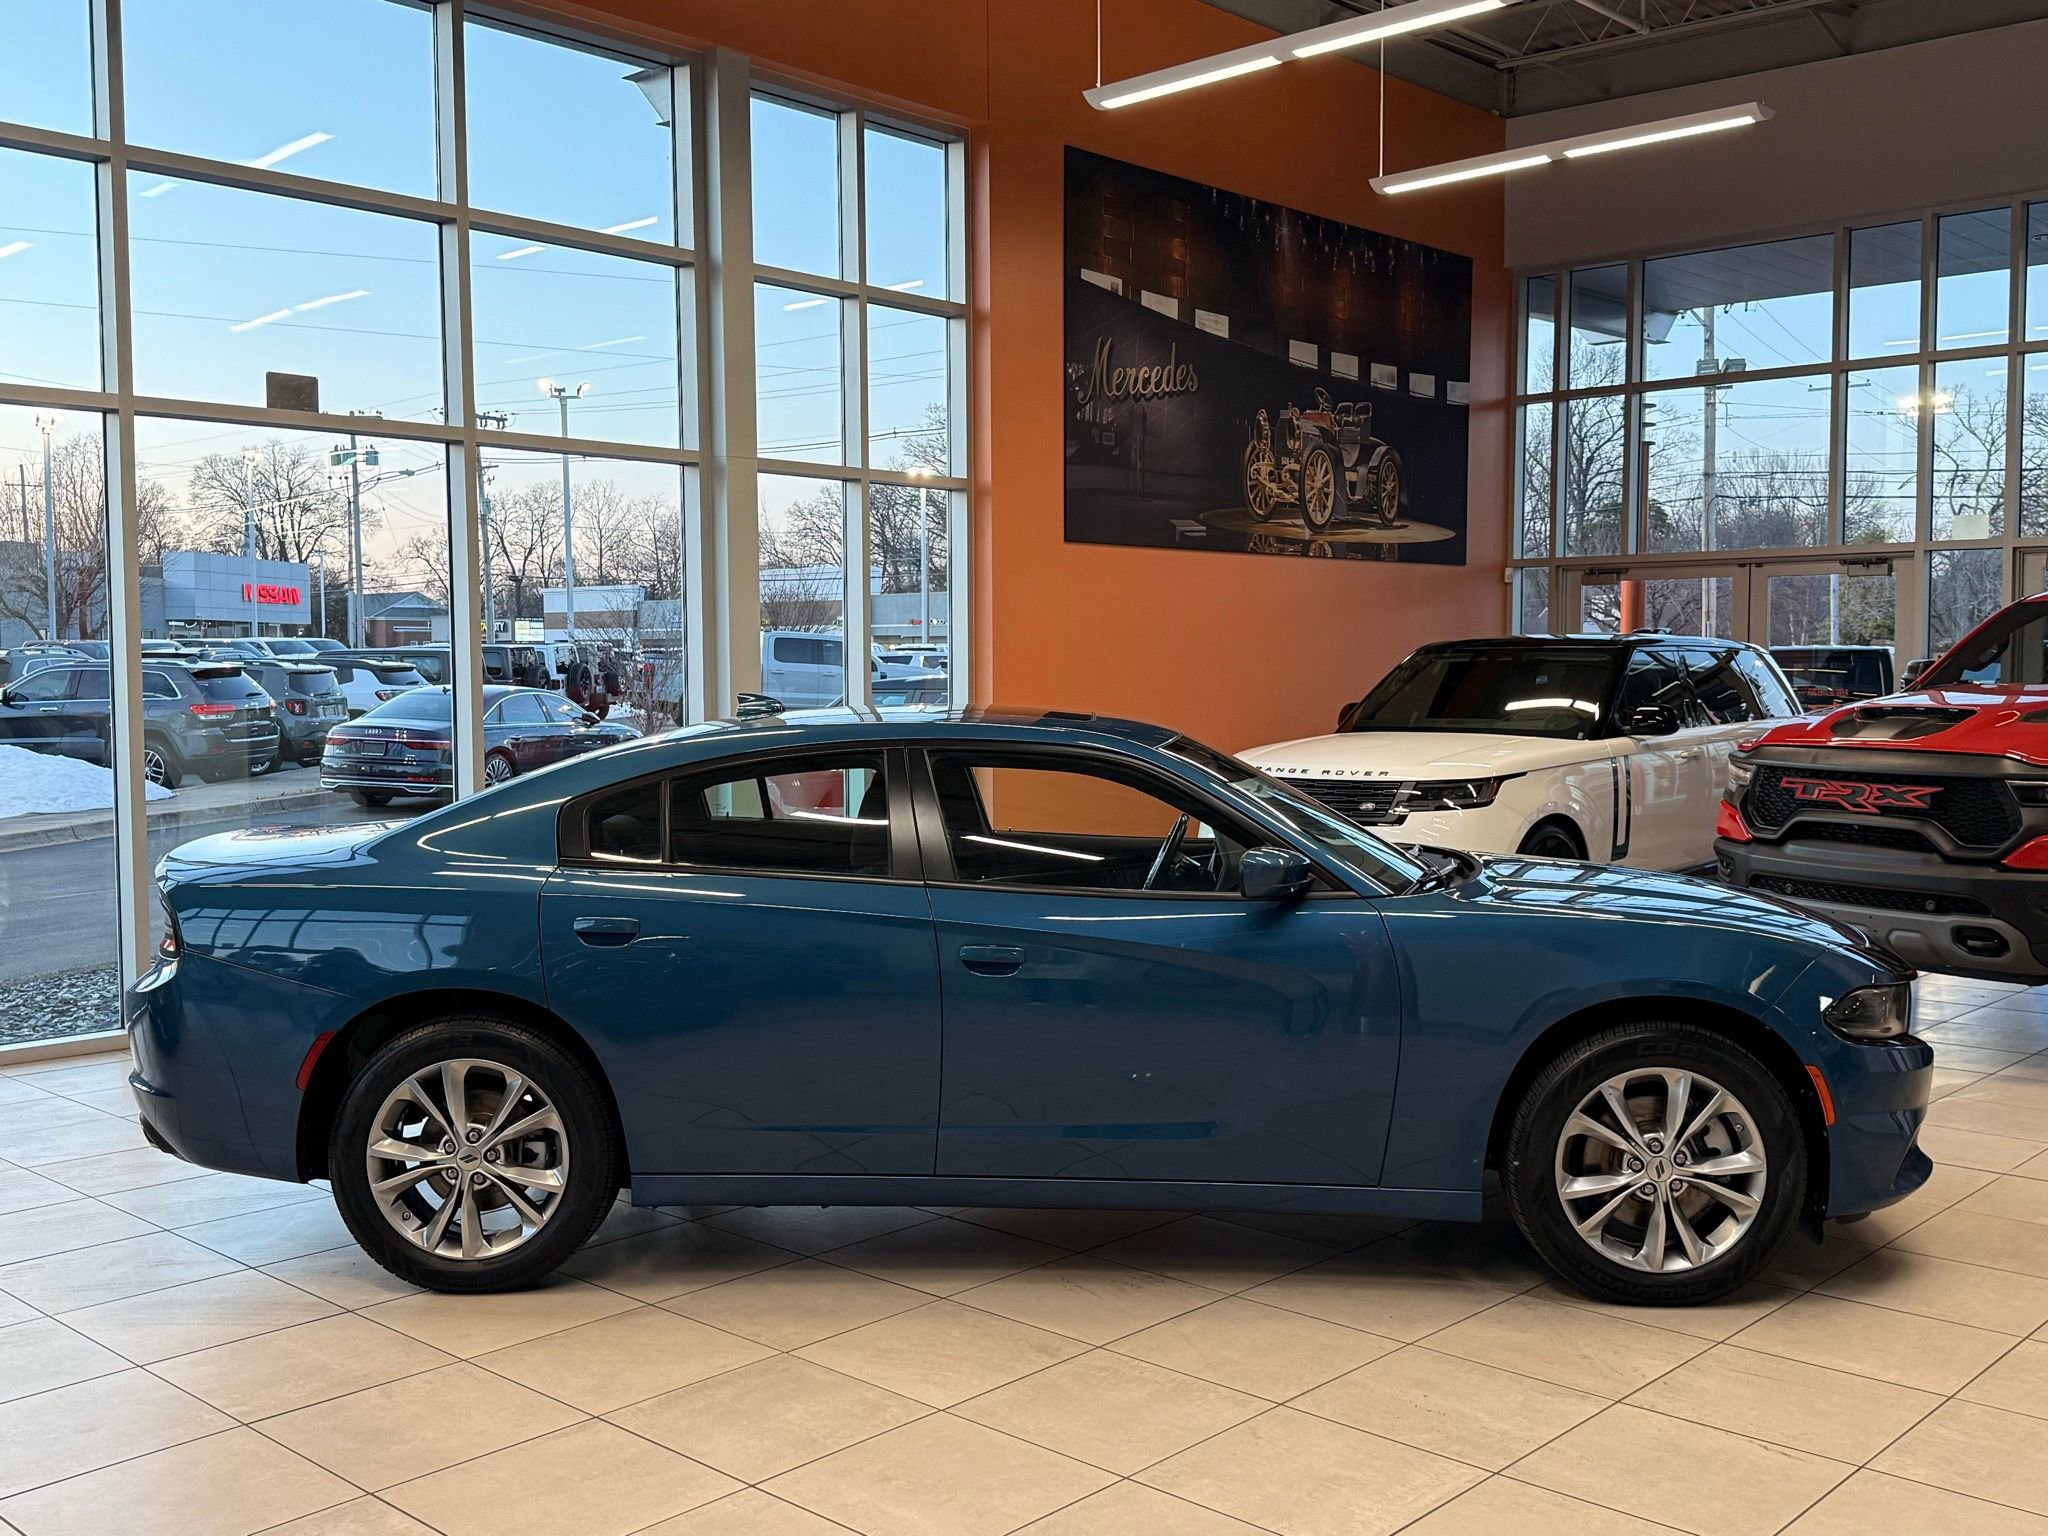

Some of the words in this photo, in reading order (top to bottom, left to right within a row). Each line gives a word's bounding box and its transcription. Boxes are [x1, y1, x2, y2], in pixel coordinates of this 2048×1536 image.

[1078, 336, 1198, 403] Mercedes
[242, 583, 301, 604] NISSAN
[1779, 777, 1945, 814] TRX
